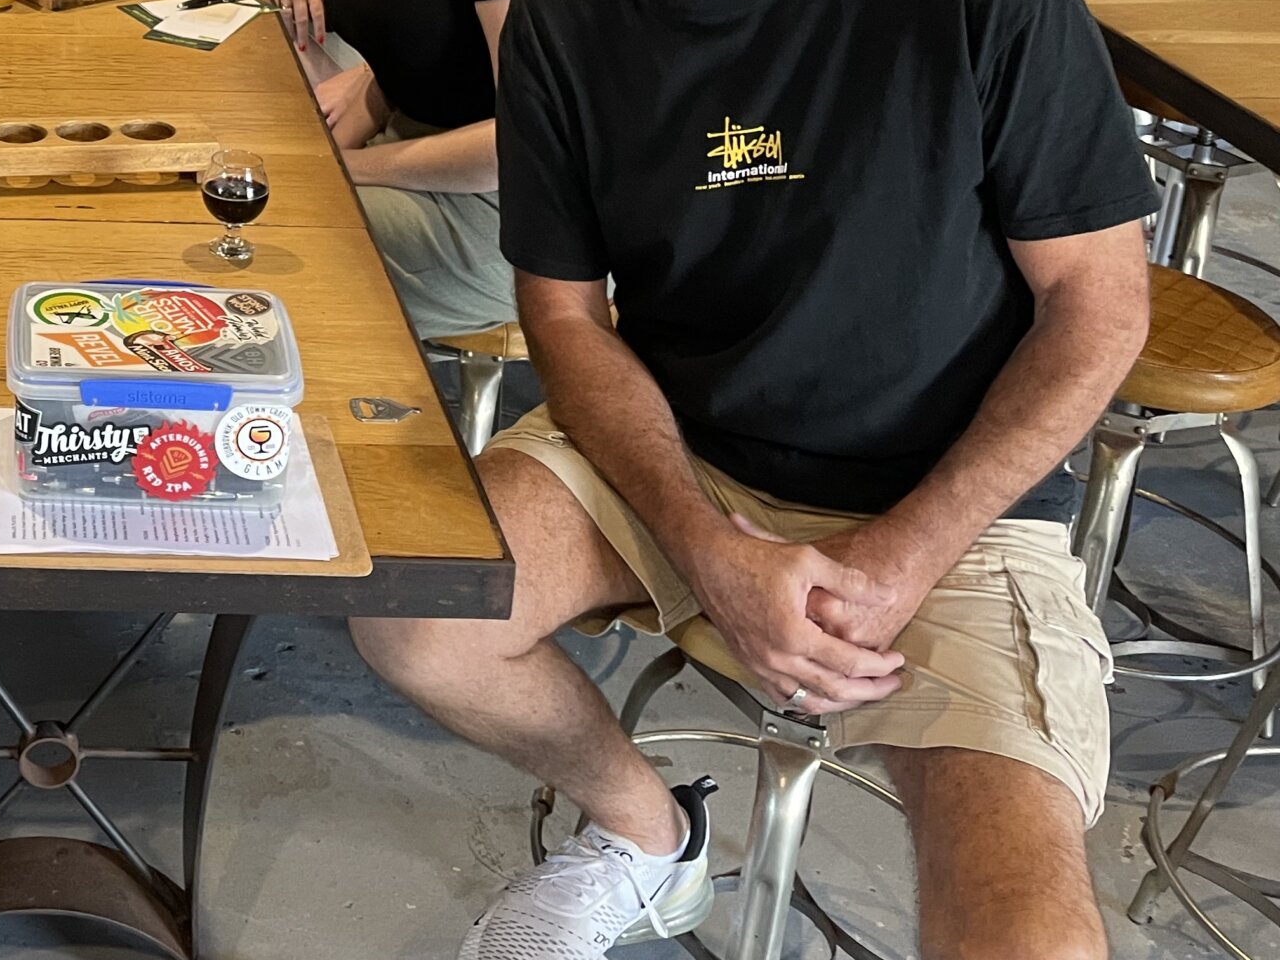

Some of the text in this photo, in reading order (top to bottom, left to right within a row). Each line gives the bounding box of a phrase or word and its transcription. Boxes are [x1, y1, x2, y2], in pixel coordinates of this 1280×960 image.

[45, 300, 90, 312] HAPPY VALLEY
[228, 297, 255, 315] WOOD
[237, 294, 268, 312] STONE
[156, 297, 197, 335] MATES
[49, 347, 62, 367] BREWING
[71, 333, 124, 366] REVEL
[245, 351, 264, 365] BH
[35, 423, 138, 462] Thirsty
[225, 407, 289, 458] DUBROVNIK OLD TOWN CRAFT
[43, 451, 108, 464] MERCHANTS
[150, 433, 209, 469] AFTERBURNER
[243, 460, 283, 477] GLAM
[142, 465, 192, 493] RED IPA
